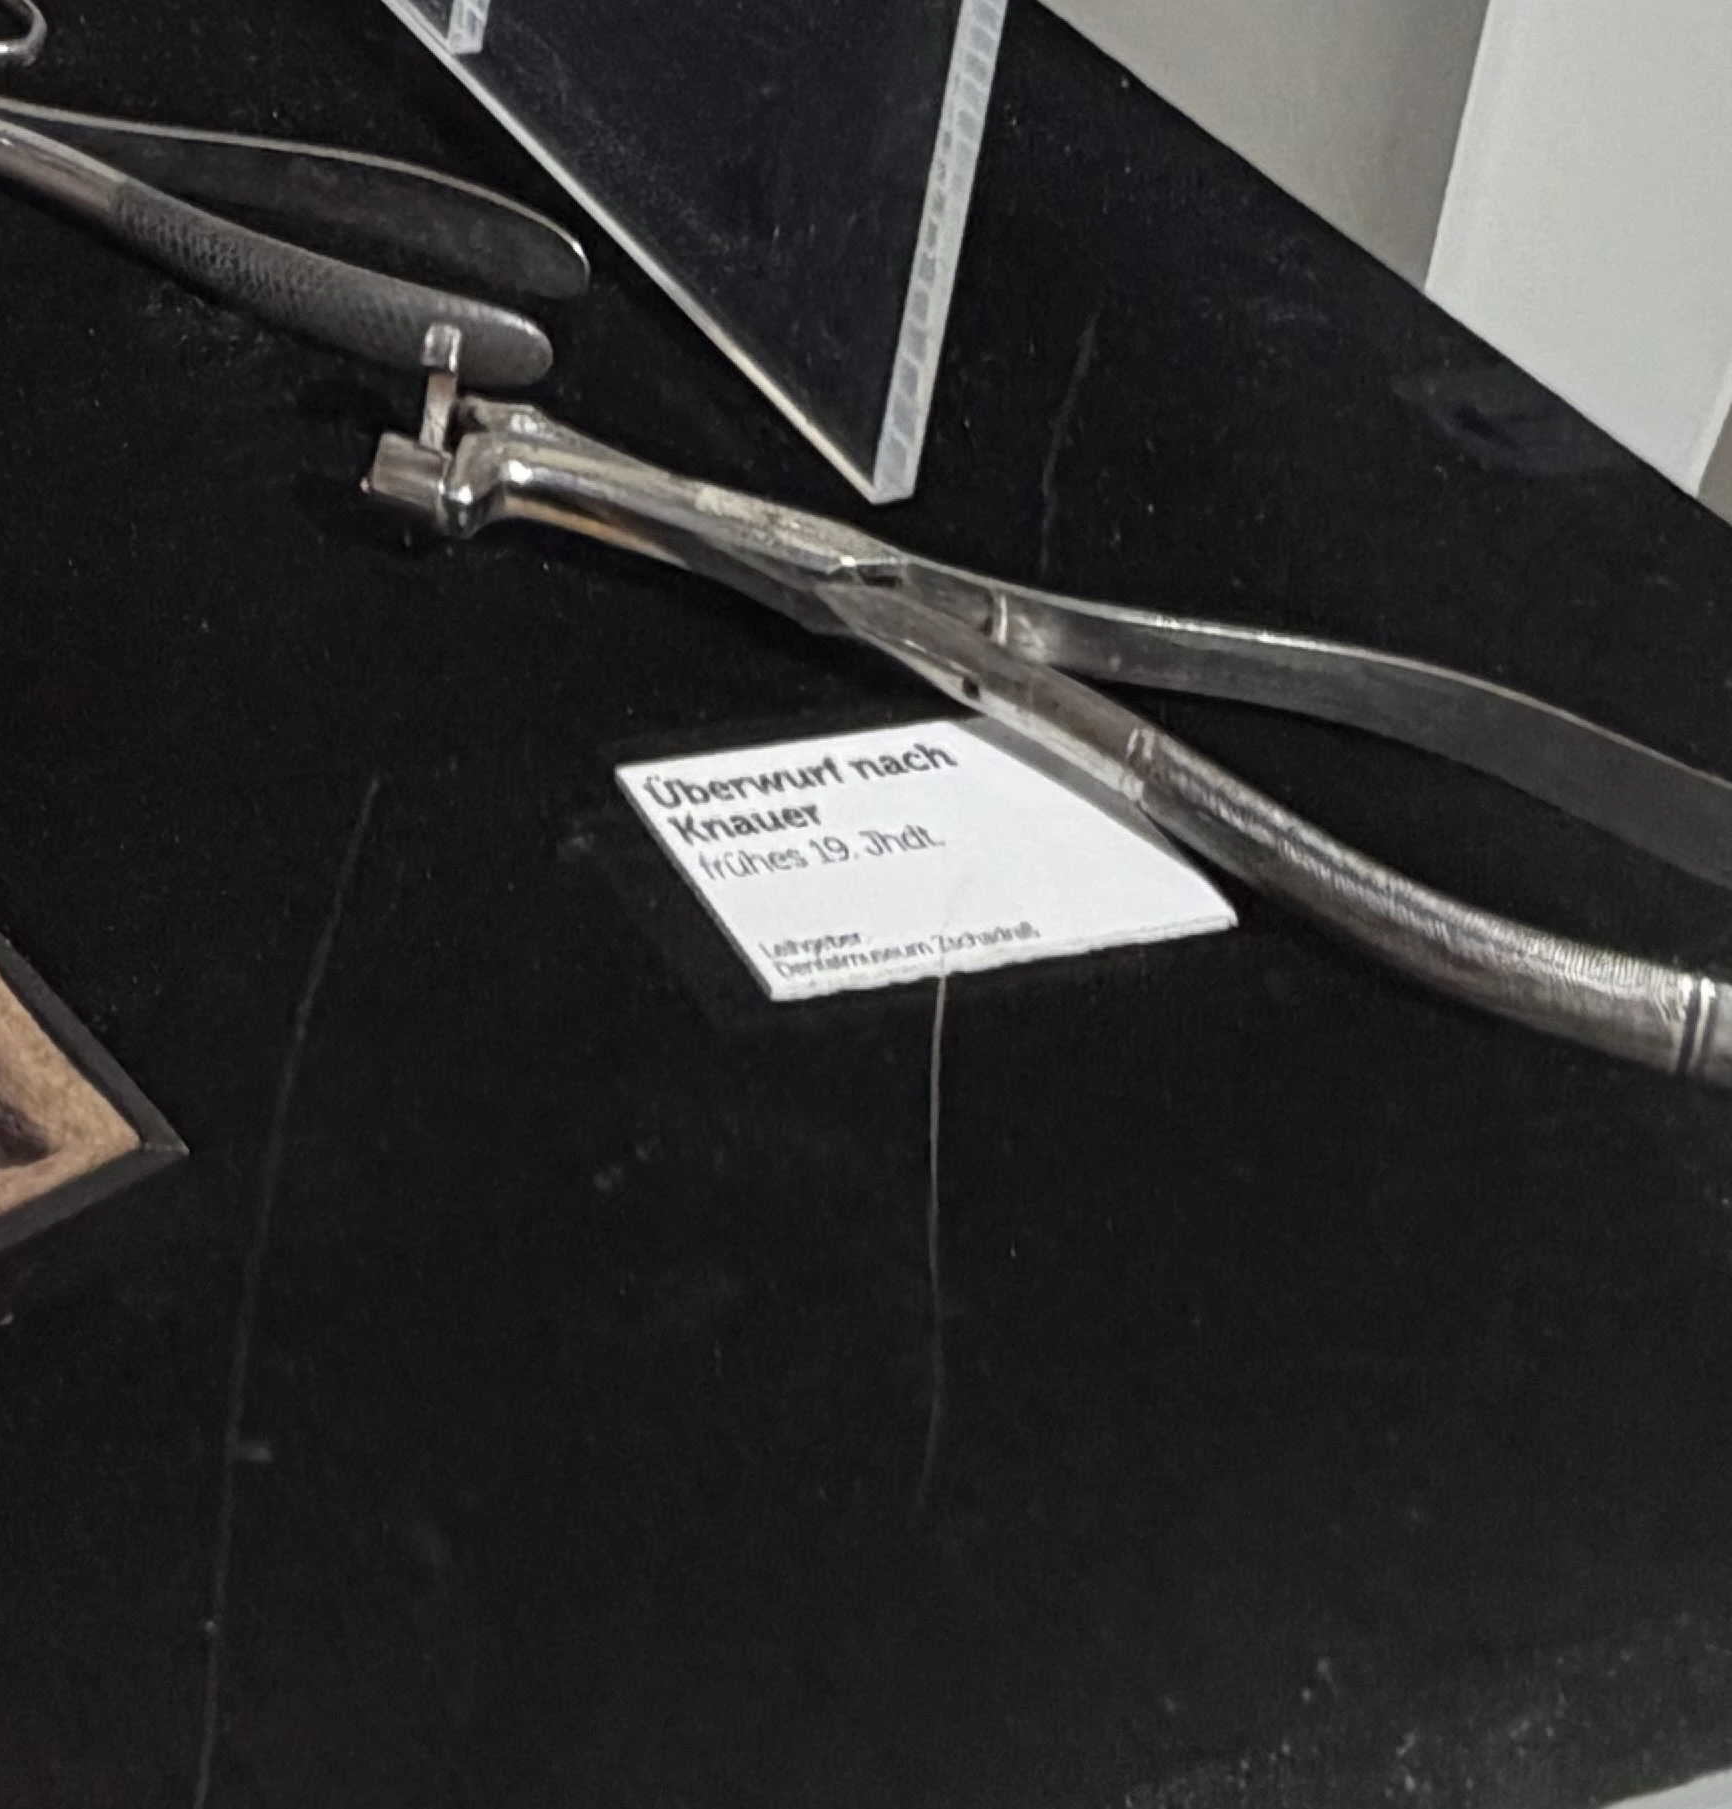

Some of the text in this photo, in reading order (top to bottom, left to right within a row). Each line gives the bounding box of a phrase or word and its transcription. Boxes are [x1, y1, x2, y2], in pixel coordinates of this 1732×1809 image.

[642, 742, 959, 809] Überwurf nach
[668, 803, 822, 846] Knauer
[698, 823, 947, 881] frühes 19. Jhdt.
